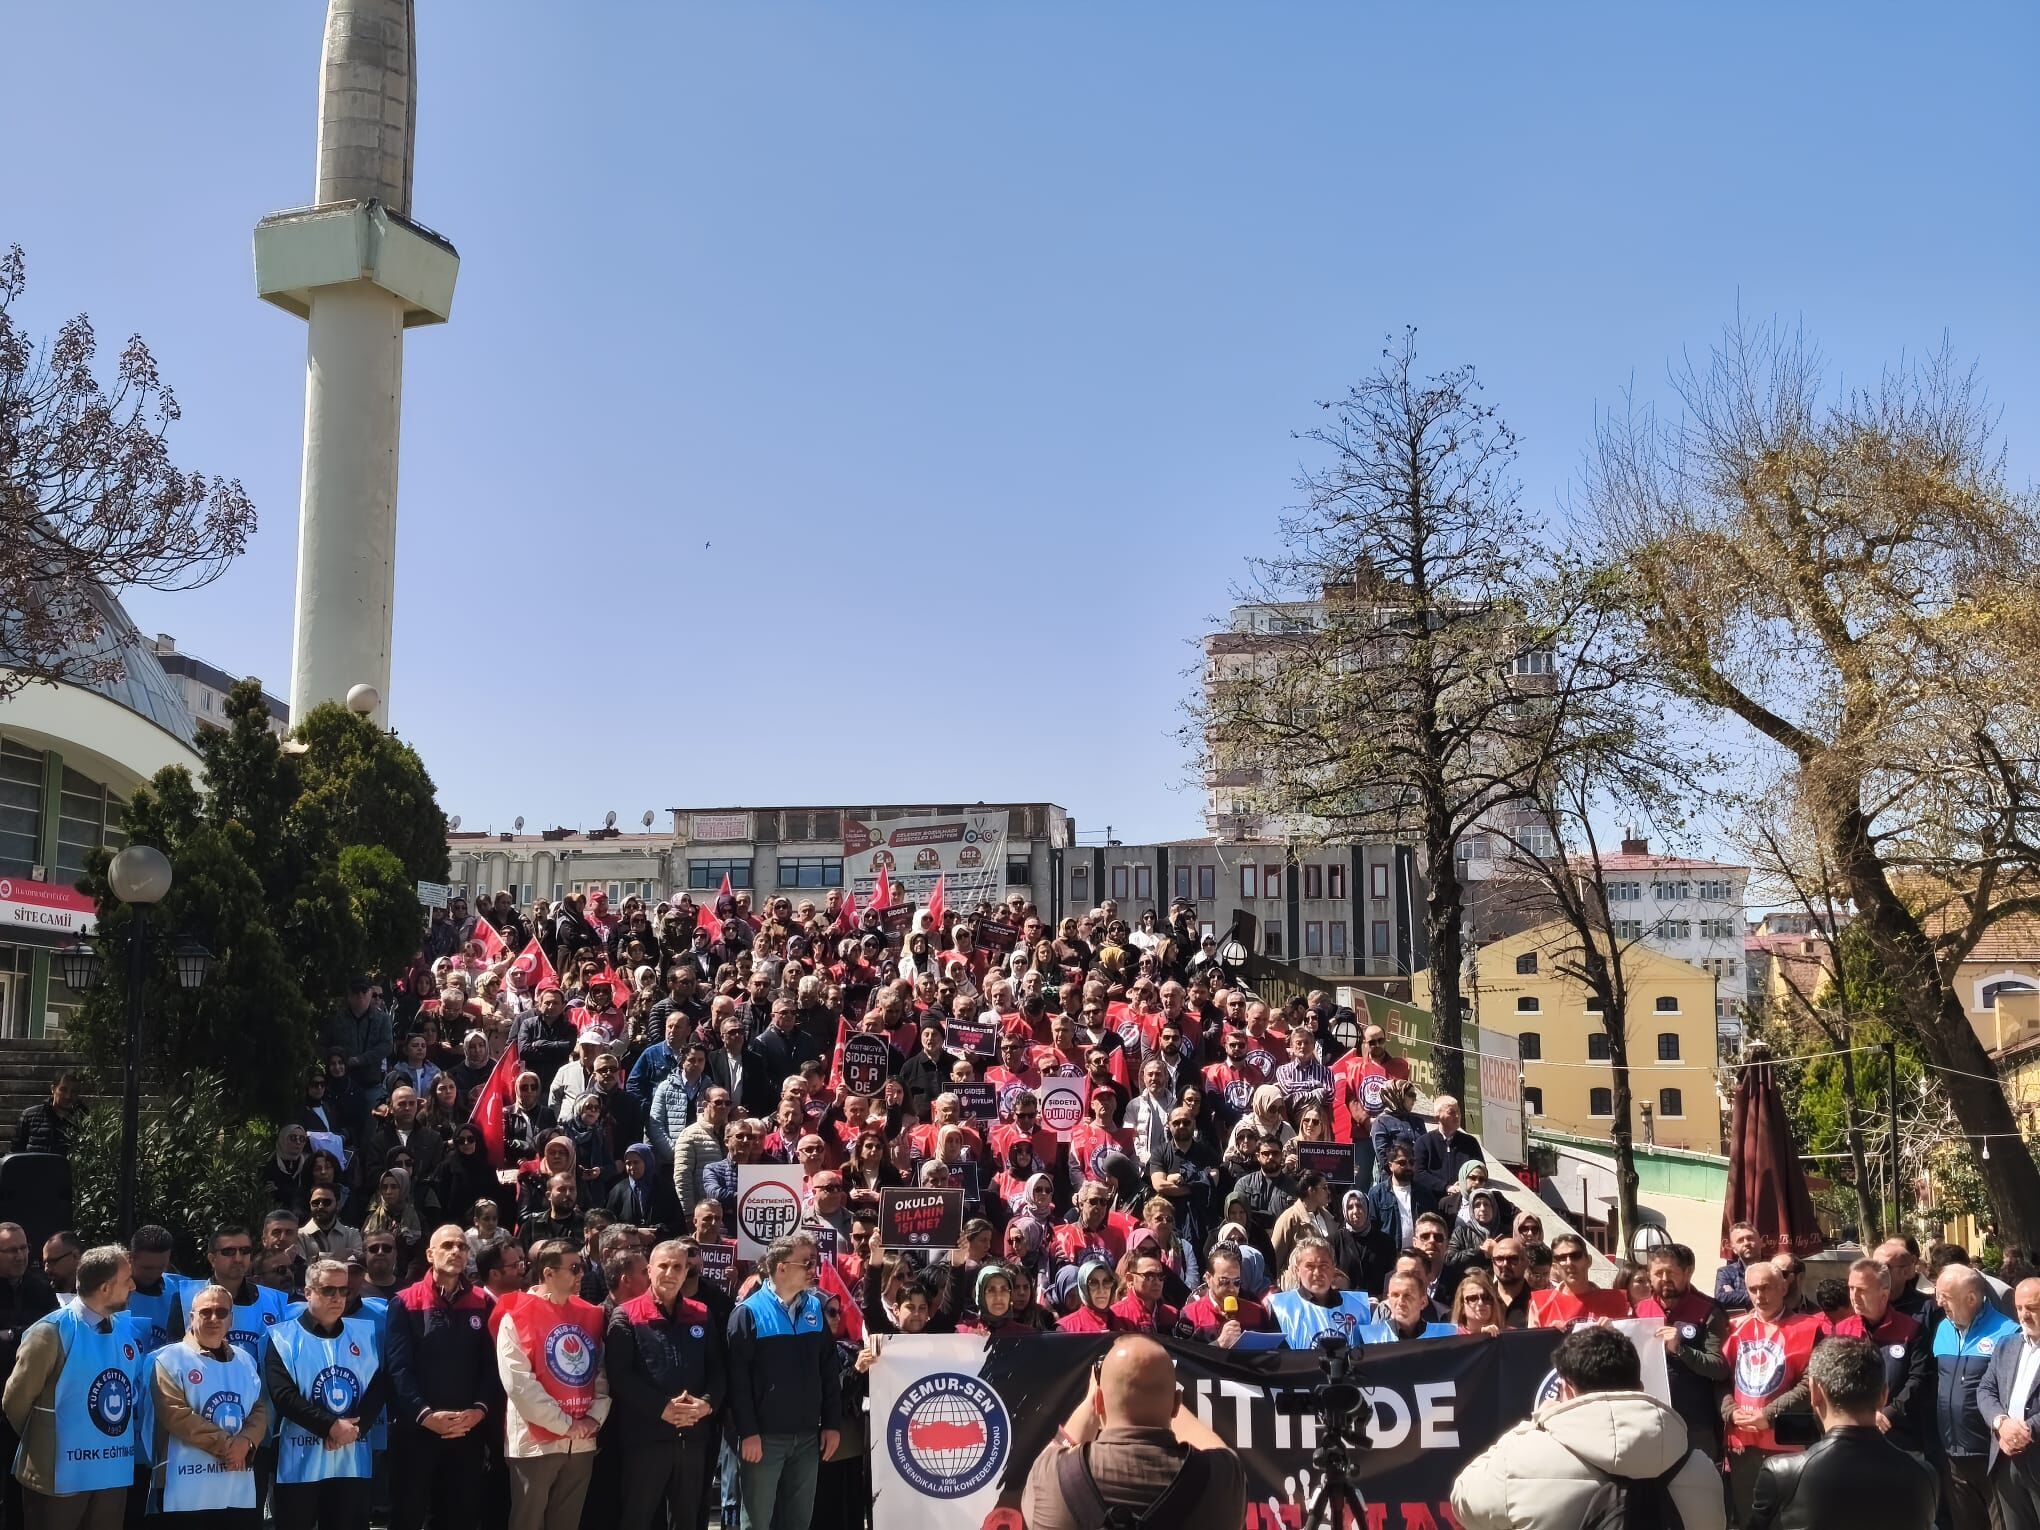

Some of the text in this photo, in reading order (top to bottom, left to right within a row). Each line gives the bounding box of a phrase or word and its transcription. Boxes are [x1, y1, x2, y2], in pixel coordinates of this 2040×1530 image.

[14, 907, 39, 923] SİTE
[845, 1051, 886, 1065] ŞİDDETE
[855, 1081, 871, 1093] DE
[895, 1195, 945, 1211] OKULDA
[755, 1222, 785, 1239] VER
[898, 1377, 996, 1417] MEMUR-SEN
[291, 1435, 321, 1447] TÜRK
[67, 1448, 101, 1461] TÜRK
[894, 1426, 1001, 1494] MEMUR SENDİKALARI KONFEDERASYONU
